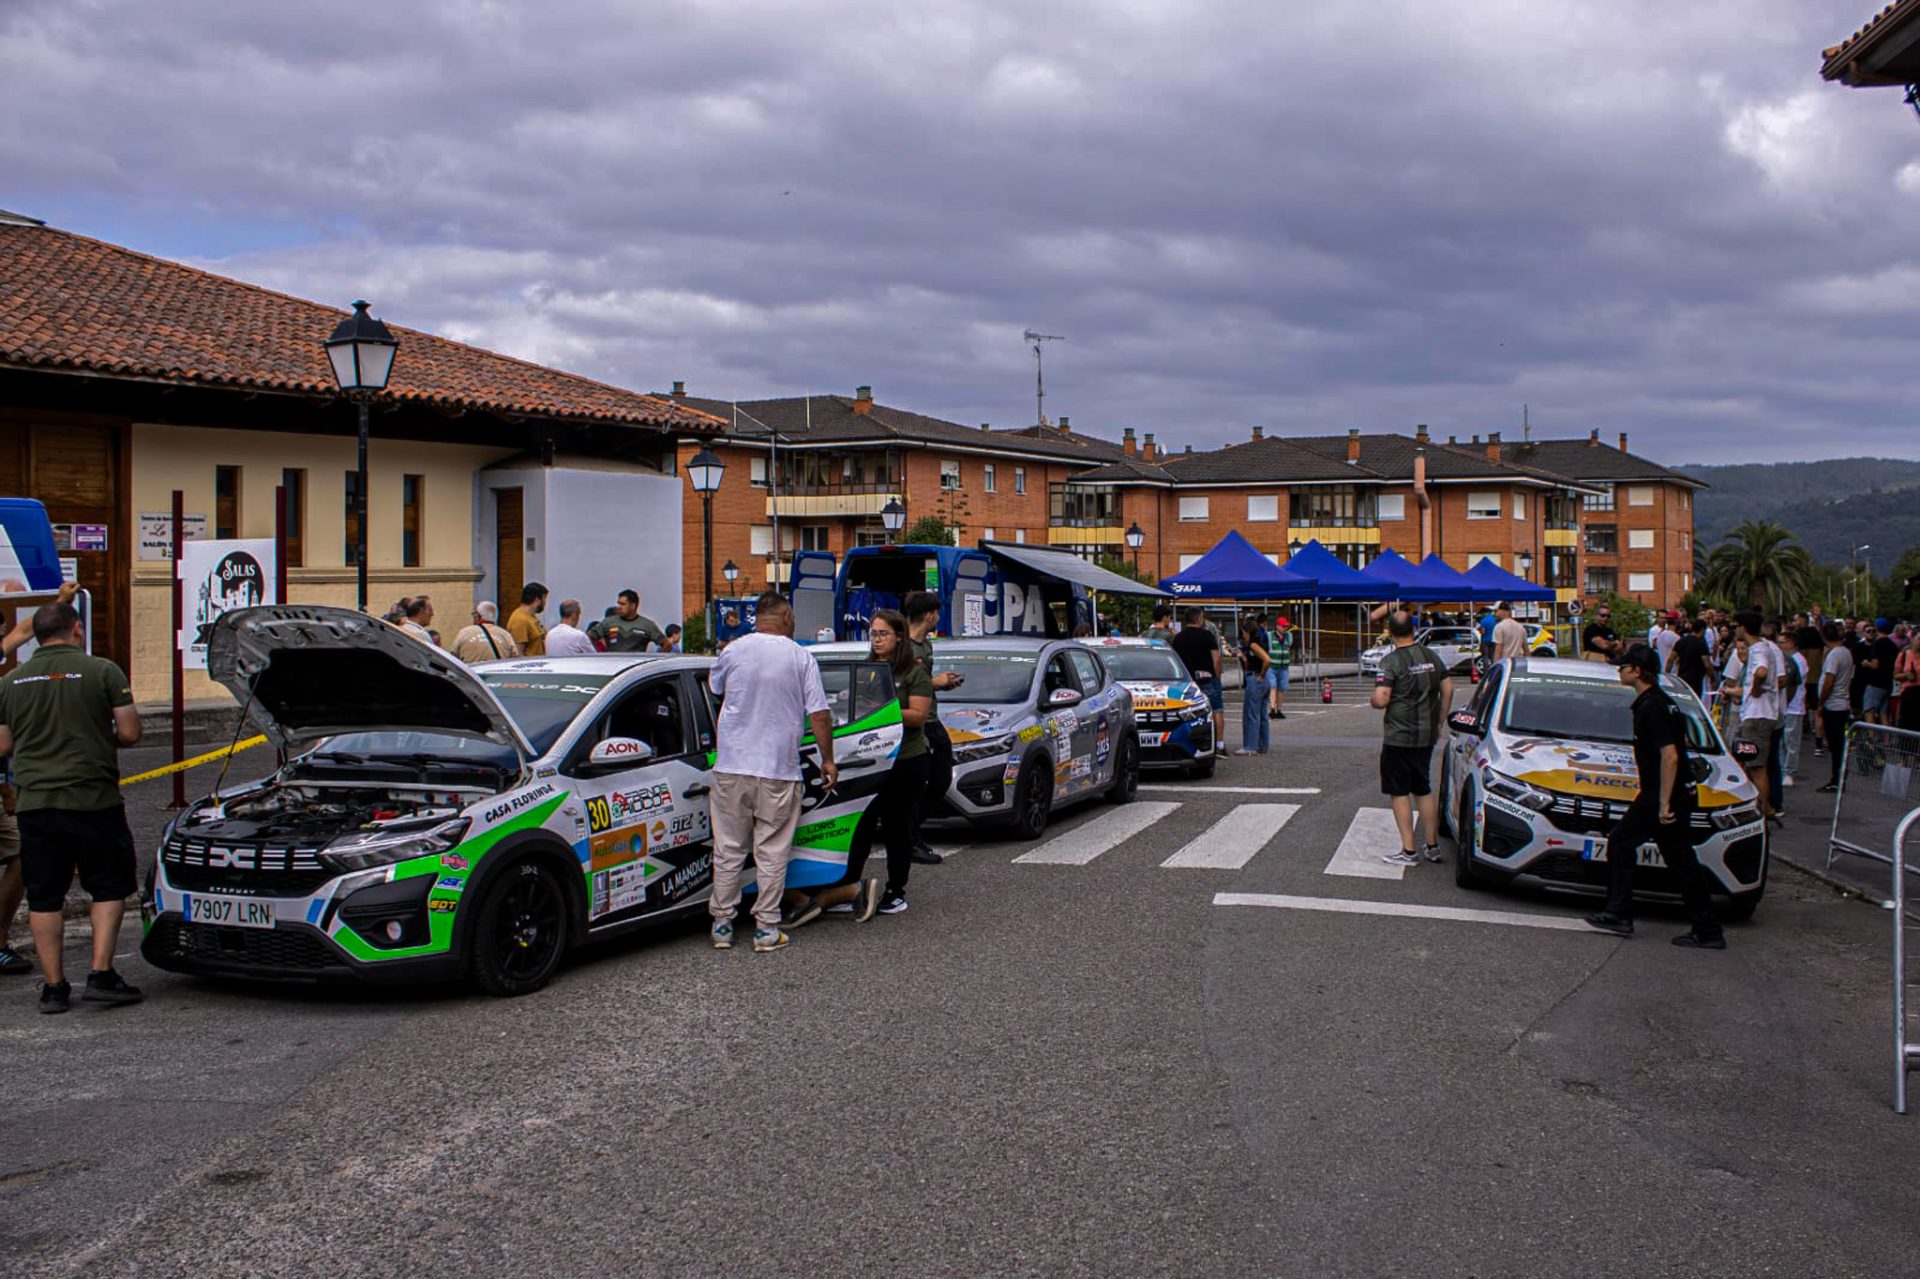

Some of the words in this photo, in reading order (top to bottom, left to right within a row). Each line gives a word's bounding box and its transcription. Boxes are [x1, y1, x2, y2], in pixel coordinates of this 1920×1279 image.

[1002, 581, 1046, 633] PA
[605, 743, 639, 756] AON
[485, 803, 512, 823] CASA
[511, 783, 555, 810] FLORINDA
[588, 799, 609, 830] 30
[672, 833, 690, 846] AON
[209, 886, 256, 894] STEPWAY
[662, 880, 675, 897] LA
[192, 899, 233, 921] 7907
[238, 902, 270, 924] LRN
